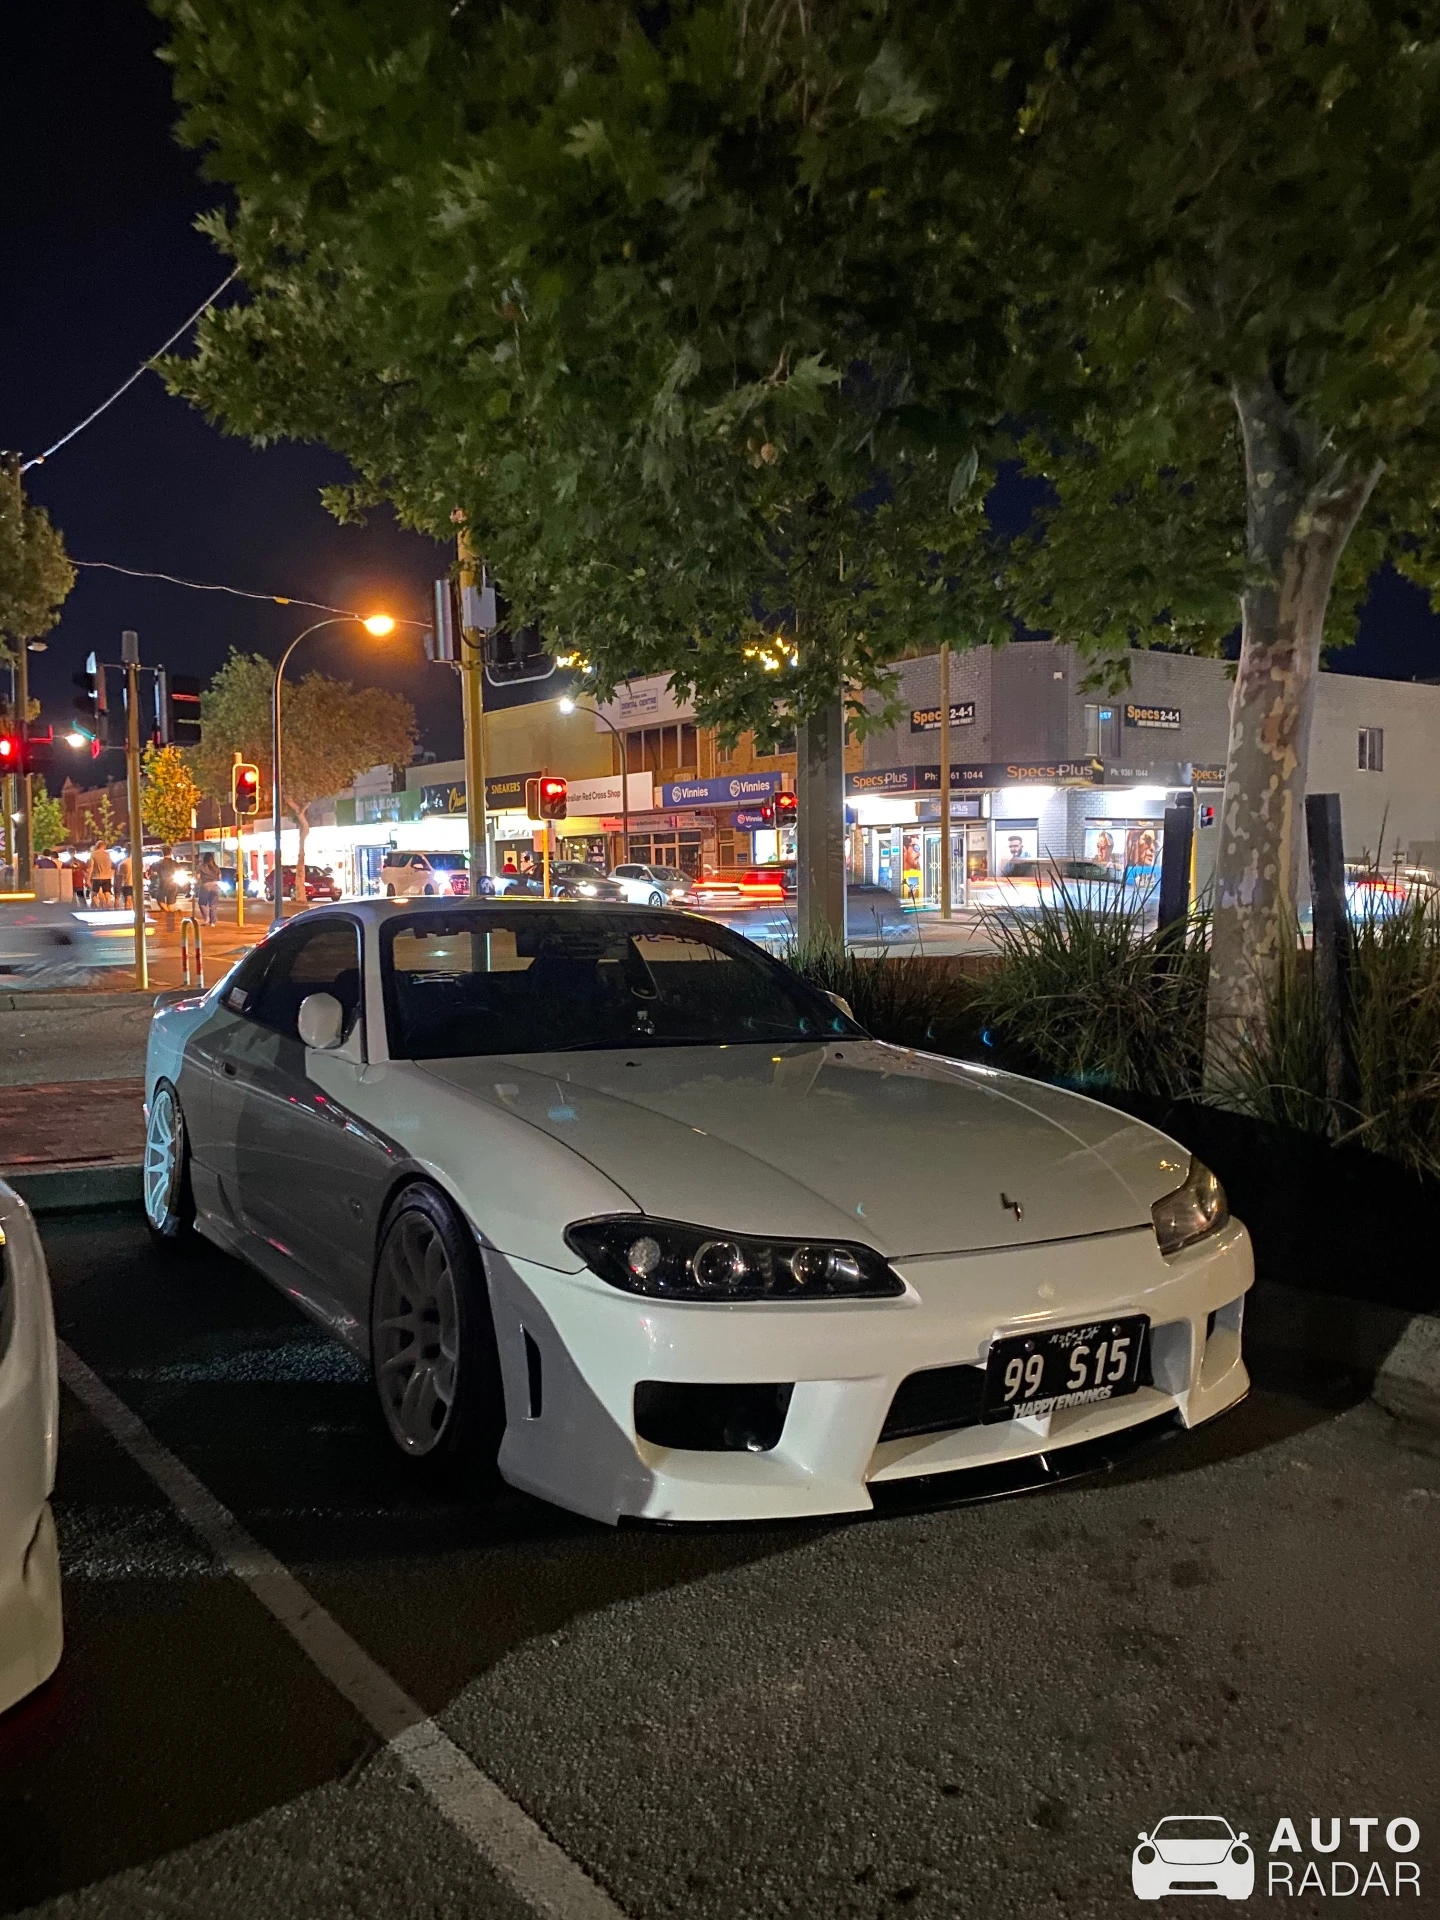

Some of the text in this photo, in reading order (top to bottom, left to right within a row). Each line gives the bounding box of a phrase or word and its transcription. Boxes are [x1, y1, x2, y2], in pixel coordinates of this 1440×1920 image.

[913, 711, 942, 726] Spec
[950, 706, 973, 719] 2-4-1
[1128, 705, 1159, 721] Specs
[1160, 710, 1180, 722] 2-4-1
[925, 772, 938, 781] Ph:
[963, 771, 984, 779] 1044
[491, 781, 521, 795] SNEAKERS
[682, 787, 709, 799] Vinnies
[741, 780, 770, 793] Vinnies
[582, 792, 592, 801] Red
[592, 791, 607, 800] Cross
[607, 789, 621, 798] Shop
[1003, 1337, 1130, 1402] 99 S15
